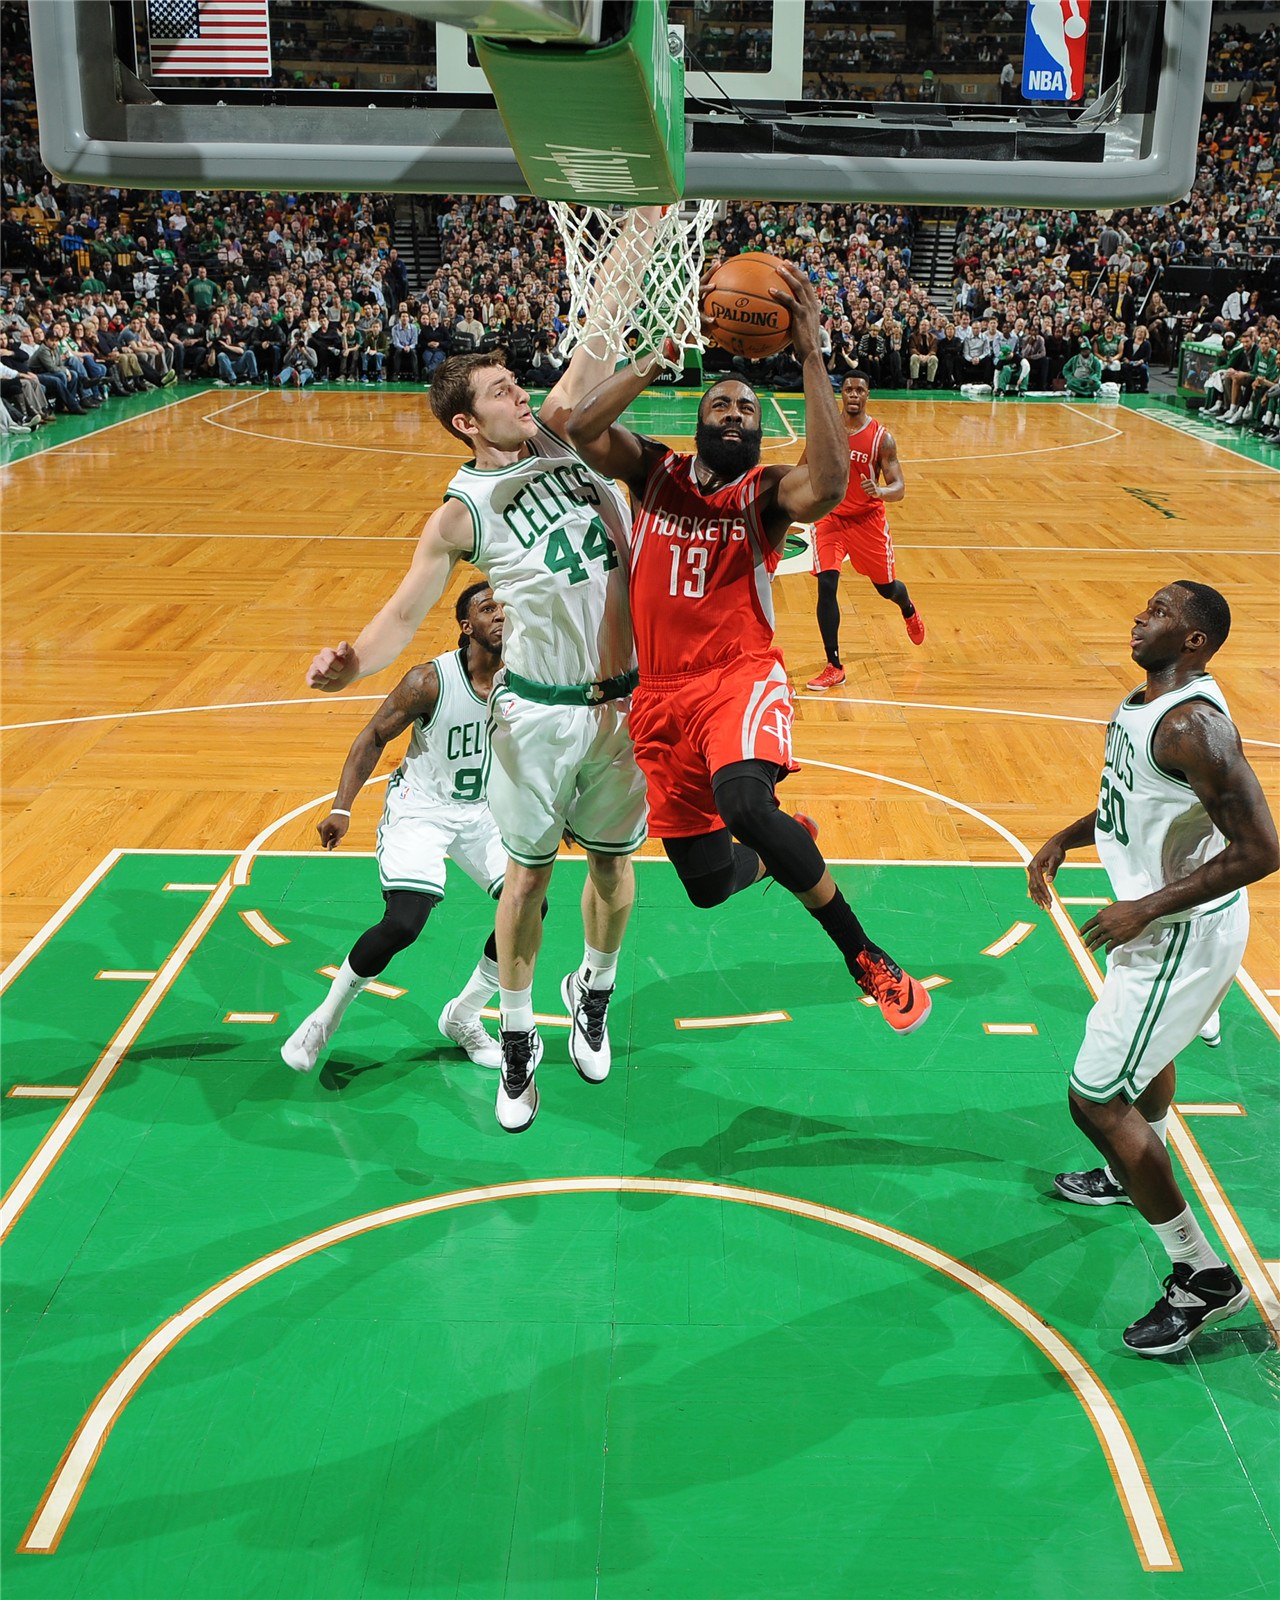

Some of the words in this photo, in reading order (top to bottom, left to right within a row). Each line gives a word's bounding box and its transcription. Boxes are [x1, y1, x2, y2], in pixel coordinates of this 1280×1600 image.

[1028, 70, 1064, 91] NBA
[711, 301, 779, 329] SPALDING
[502, 463, 601, 549] CELTICS
[651, 506, 746, 542] ROCKETS
[543, 515, 619, 585] 44
[669, 544, 708, 598] 13
[447, 721, 486, 760] CEL
[451, 768, 483, 801] 9
[1096, 775, 1130, 847] 30
